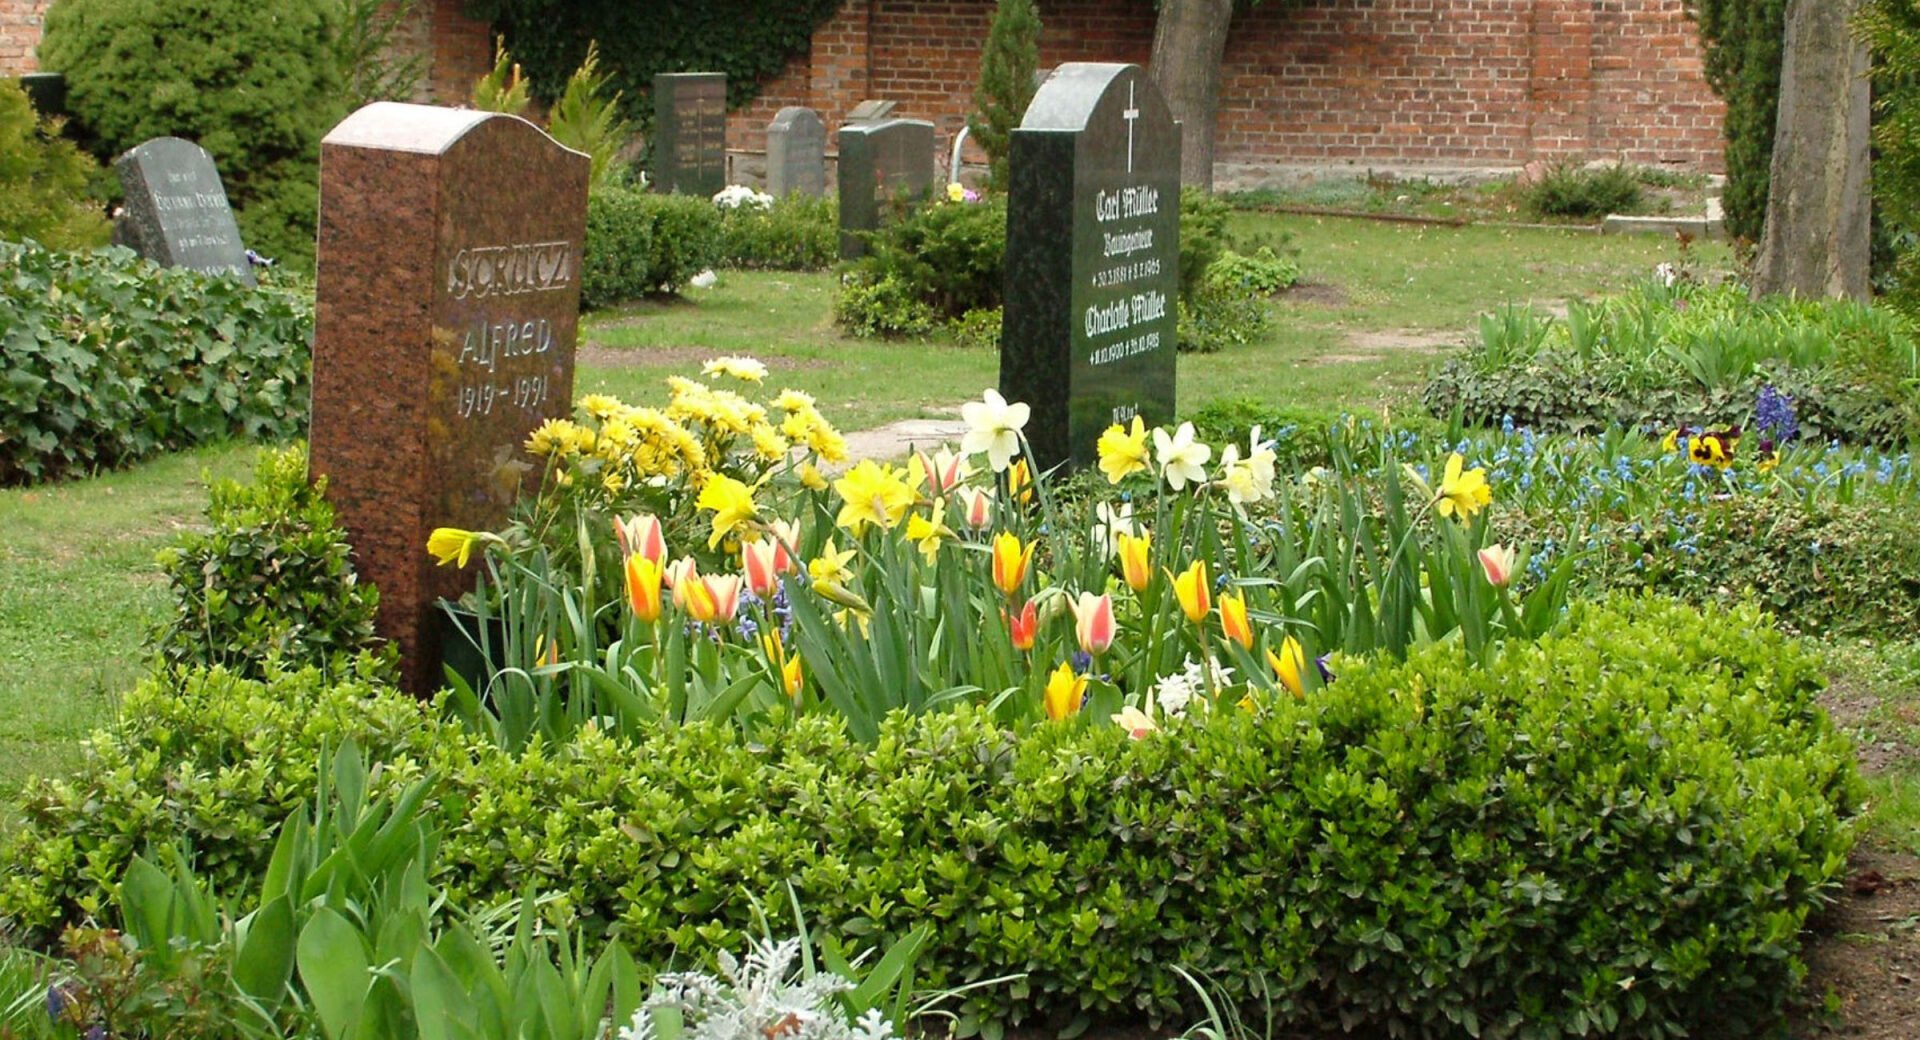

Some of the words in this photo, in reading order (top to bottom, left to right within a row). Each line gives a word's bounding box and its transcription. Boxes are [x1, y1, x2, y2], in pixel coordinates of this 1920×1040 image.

[1096, 189, 1119, 222] Carl
[1122, 185, 1159, 218] Müller
[1085, 298, 1129, 338] Charlotte
[1131, 290, 1166, 325] Müller
[458, 319, 551, 373] ALFRED
